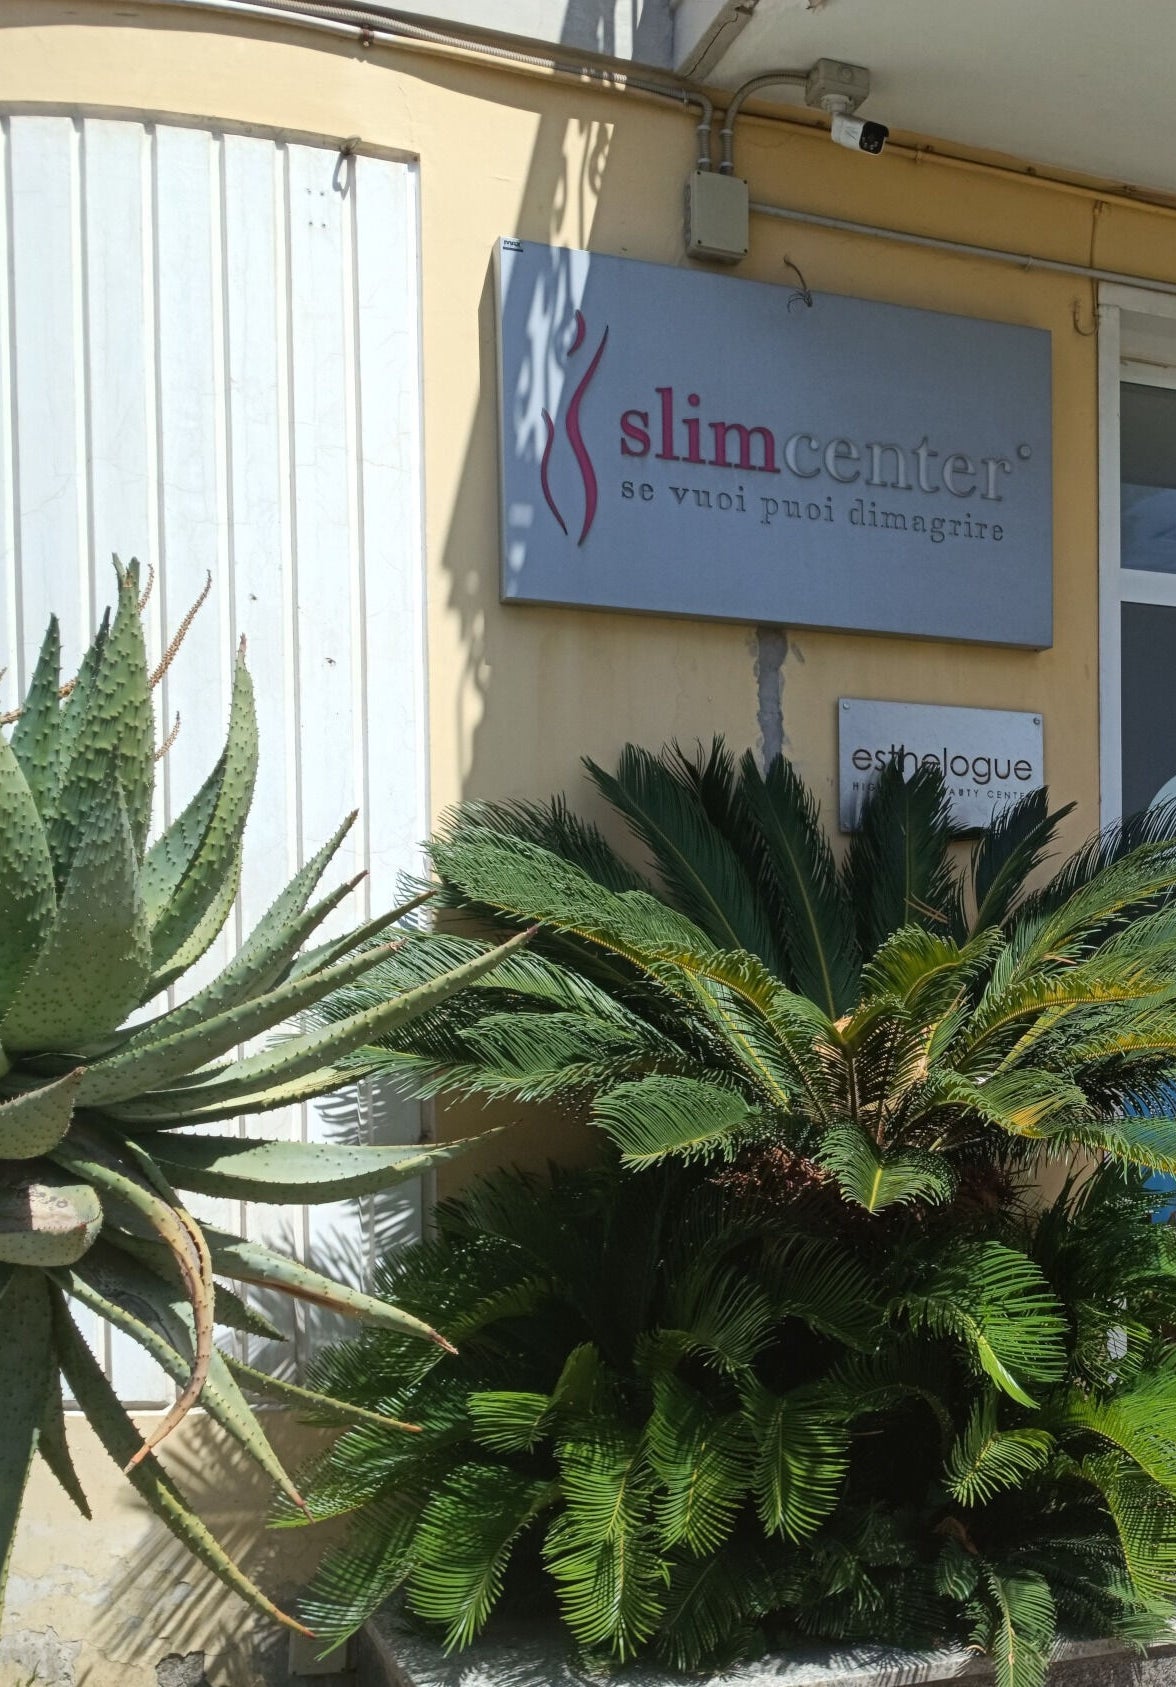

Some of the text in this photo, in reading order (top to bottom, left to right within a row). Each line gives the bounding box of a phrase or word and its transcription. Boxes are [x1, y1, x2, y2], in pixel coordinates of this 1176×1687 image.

[621, 479, 1005, 544] se vuoi puoi dimagrire
[986, 789, 1028, 800] CENTE
